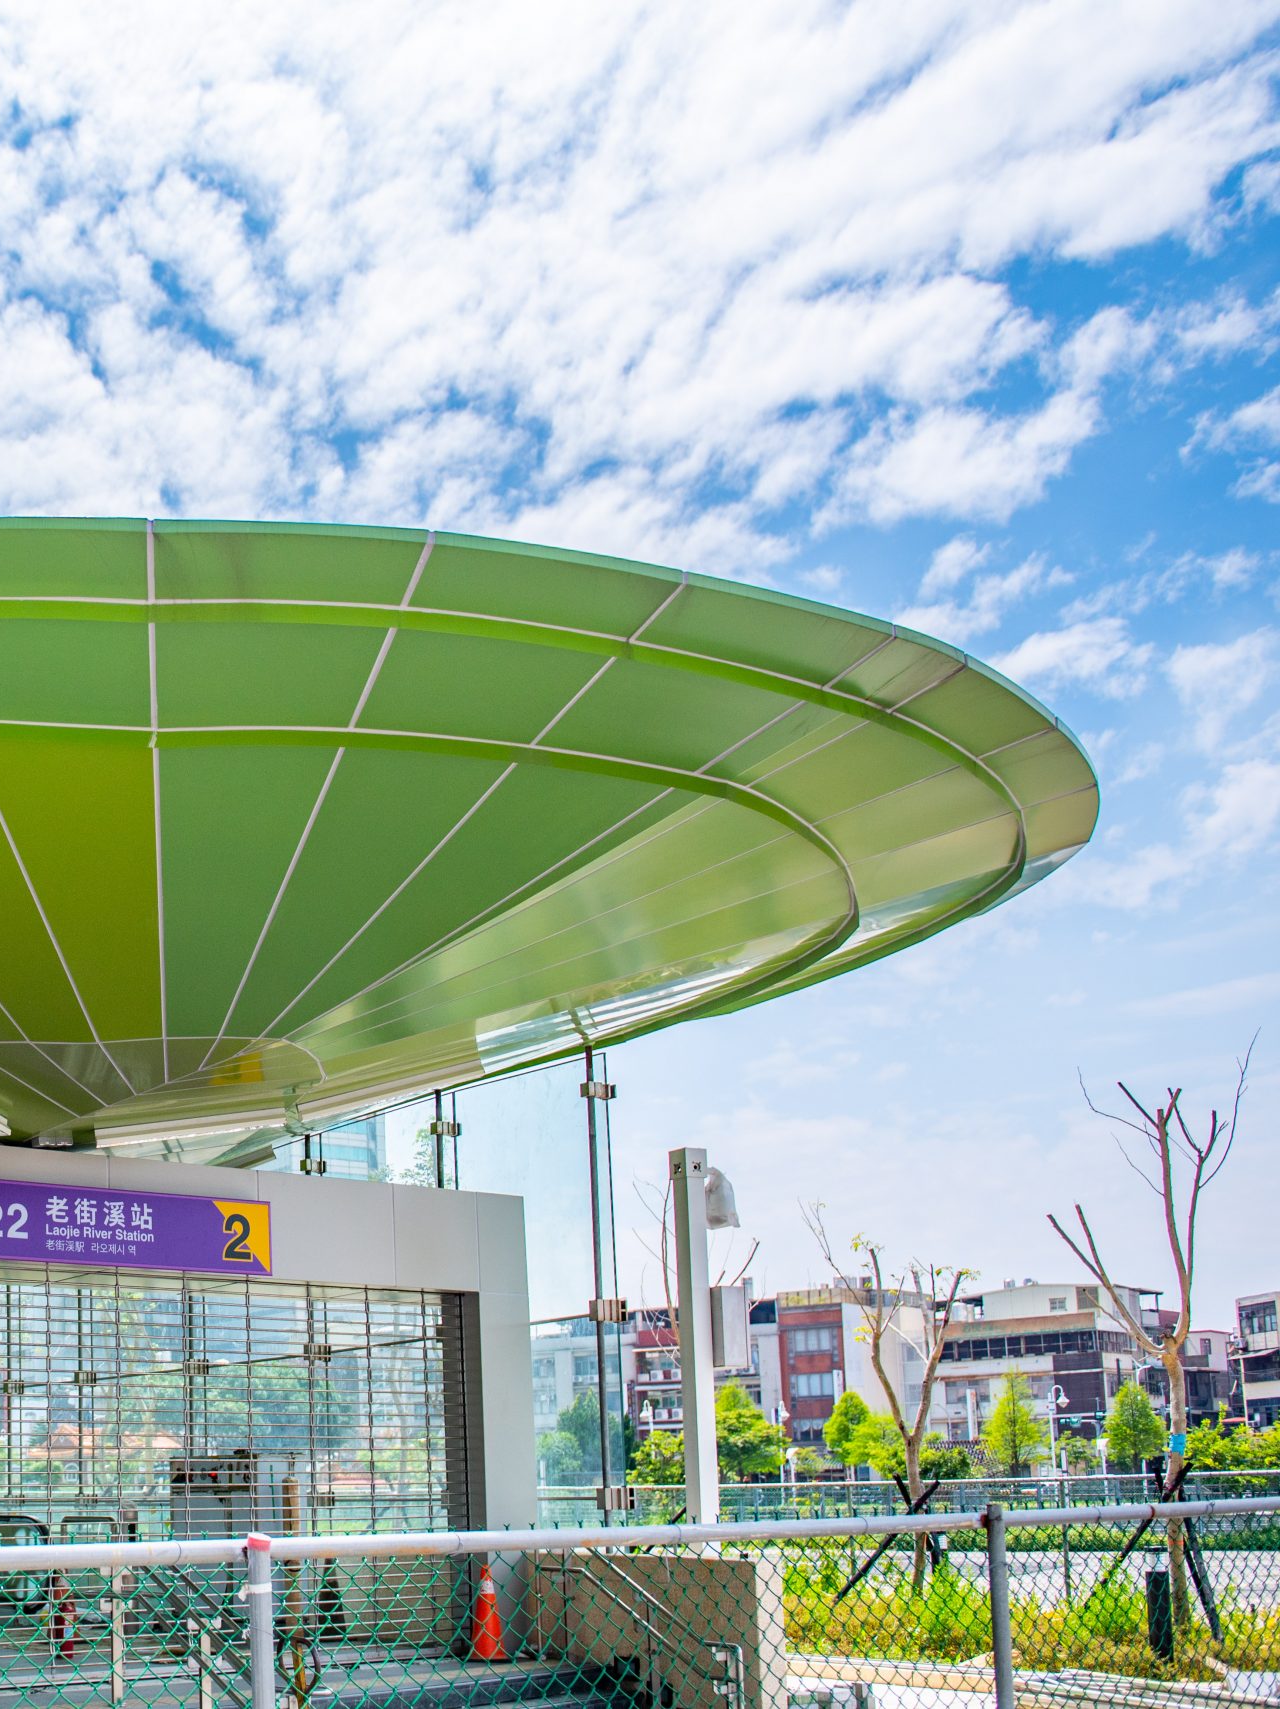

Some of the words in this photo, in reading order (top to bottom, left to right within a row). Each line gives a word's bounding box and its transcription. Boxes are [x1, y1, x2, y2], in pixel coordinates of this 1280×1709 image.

[45, 1195, 153, 1230] 老街溪站
[45, 1224, 80, 1239] Laojie
[83, 1226, 113, 1240] River
[115, 1229, 154, 1243] Station
[223, 1213, 254, 1262] 2
[127, 1245, 137, 1256] 역
